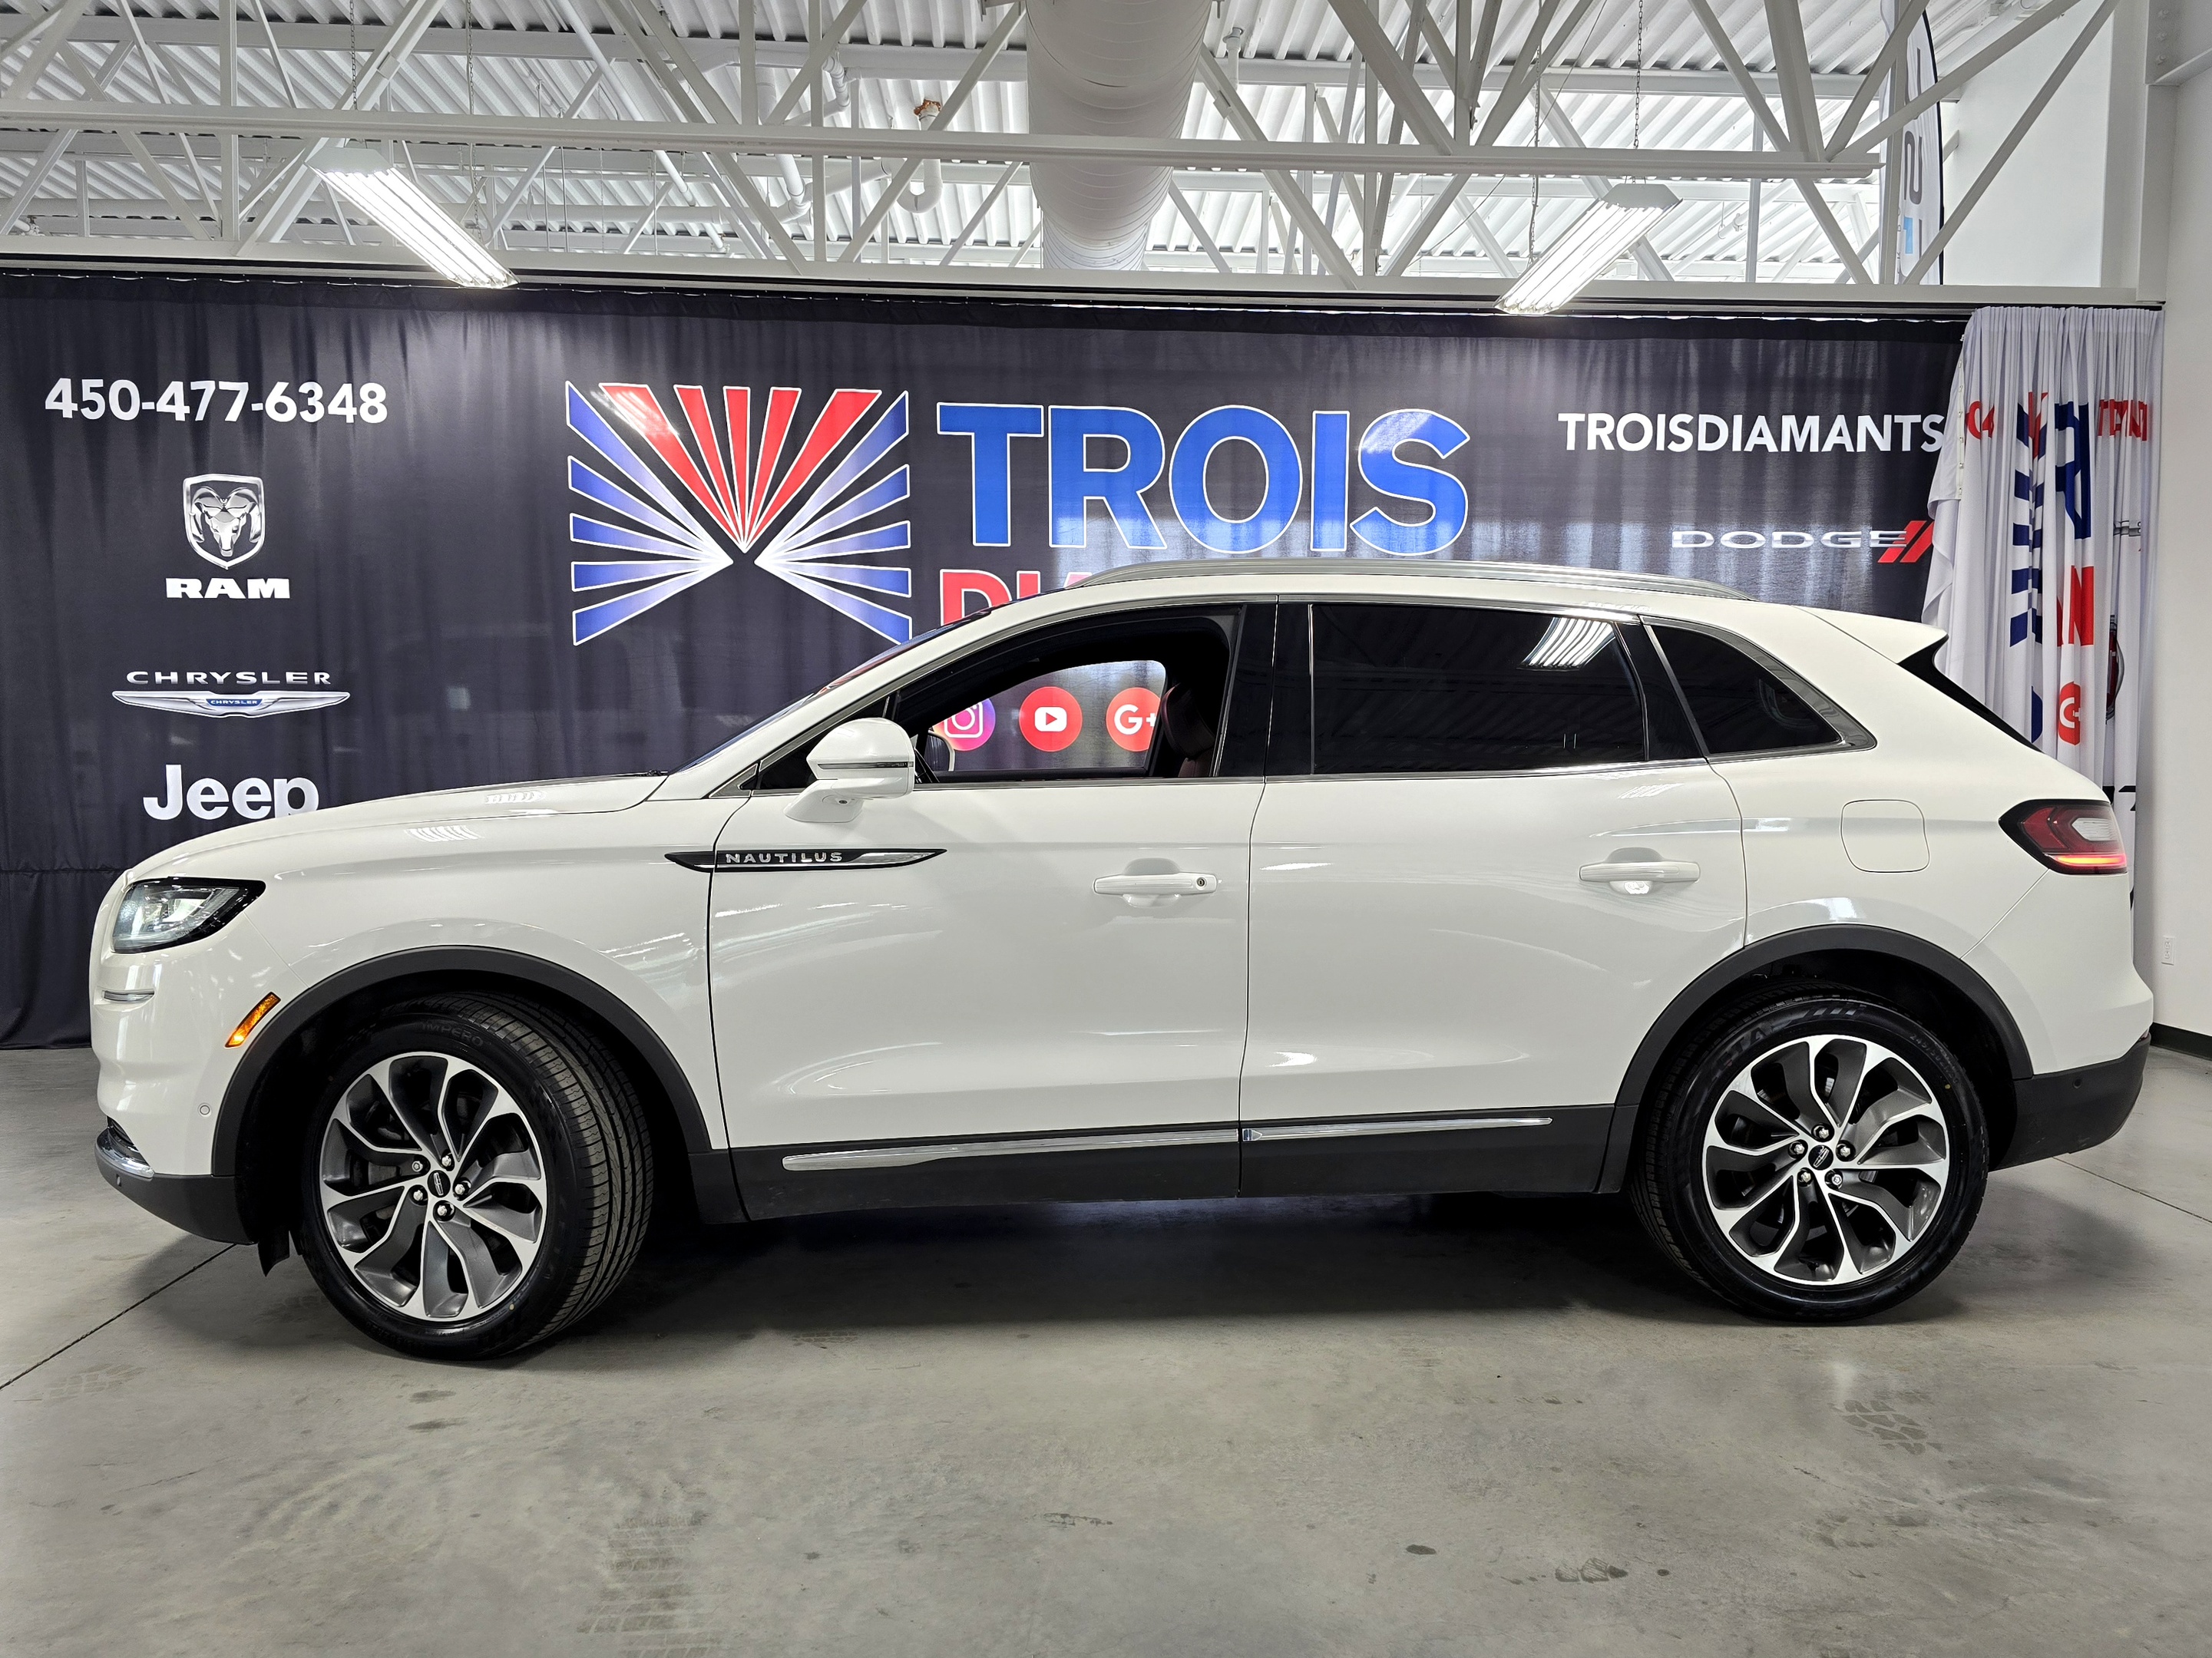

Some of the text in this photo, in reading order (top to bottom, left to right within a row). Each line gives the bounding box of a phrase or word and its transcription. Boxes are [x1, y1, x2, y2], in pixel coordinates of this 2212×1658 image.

[45, 378, 388, 423] 450-477-6348
[936, 401, 1470, 557] TROIS
[1671, 530, 1908, 549] DODGE
[165, 577, 290, 599] RAM
[126, 671, 331, 685] CHRYSLER
[143, 764, 319, 820] Jeep
[725, 851, 843, 864] NAUTILUS
